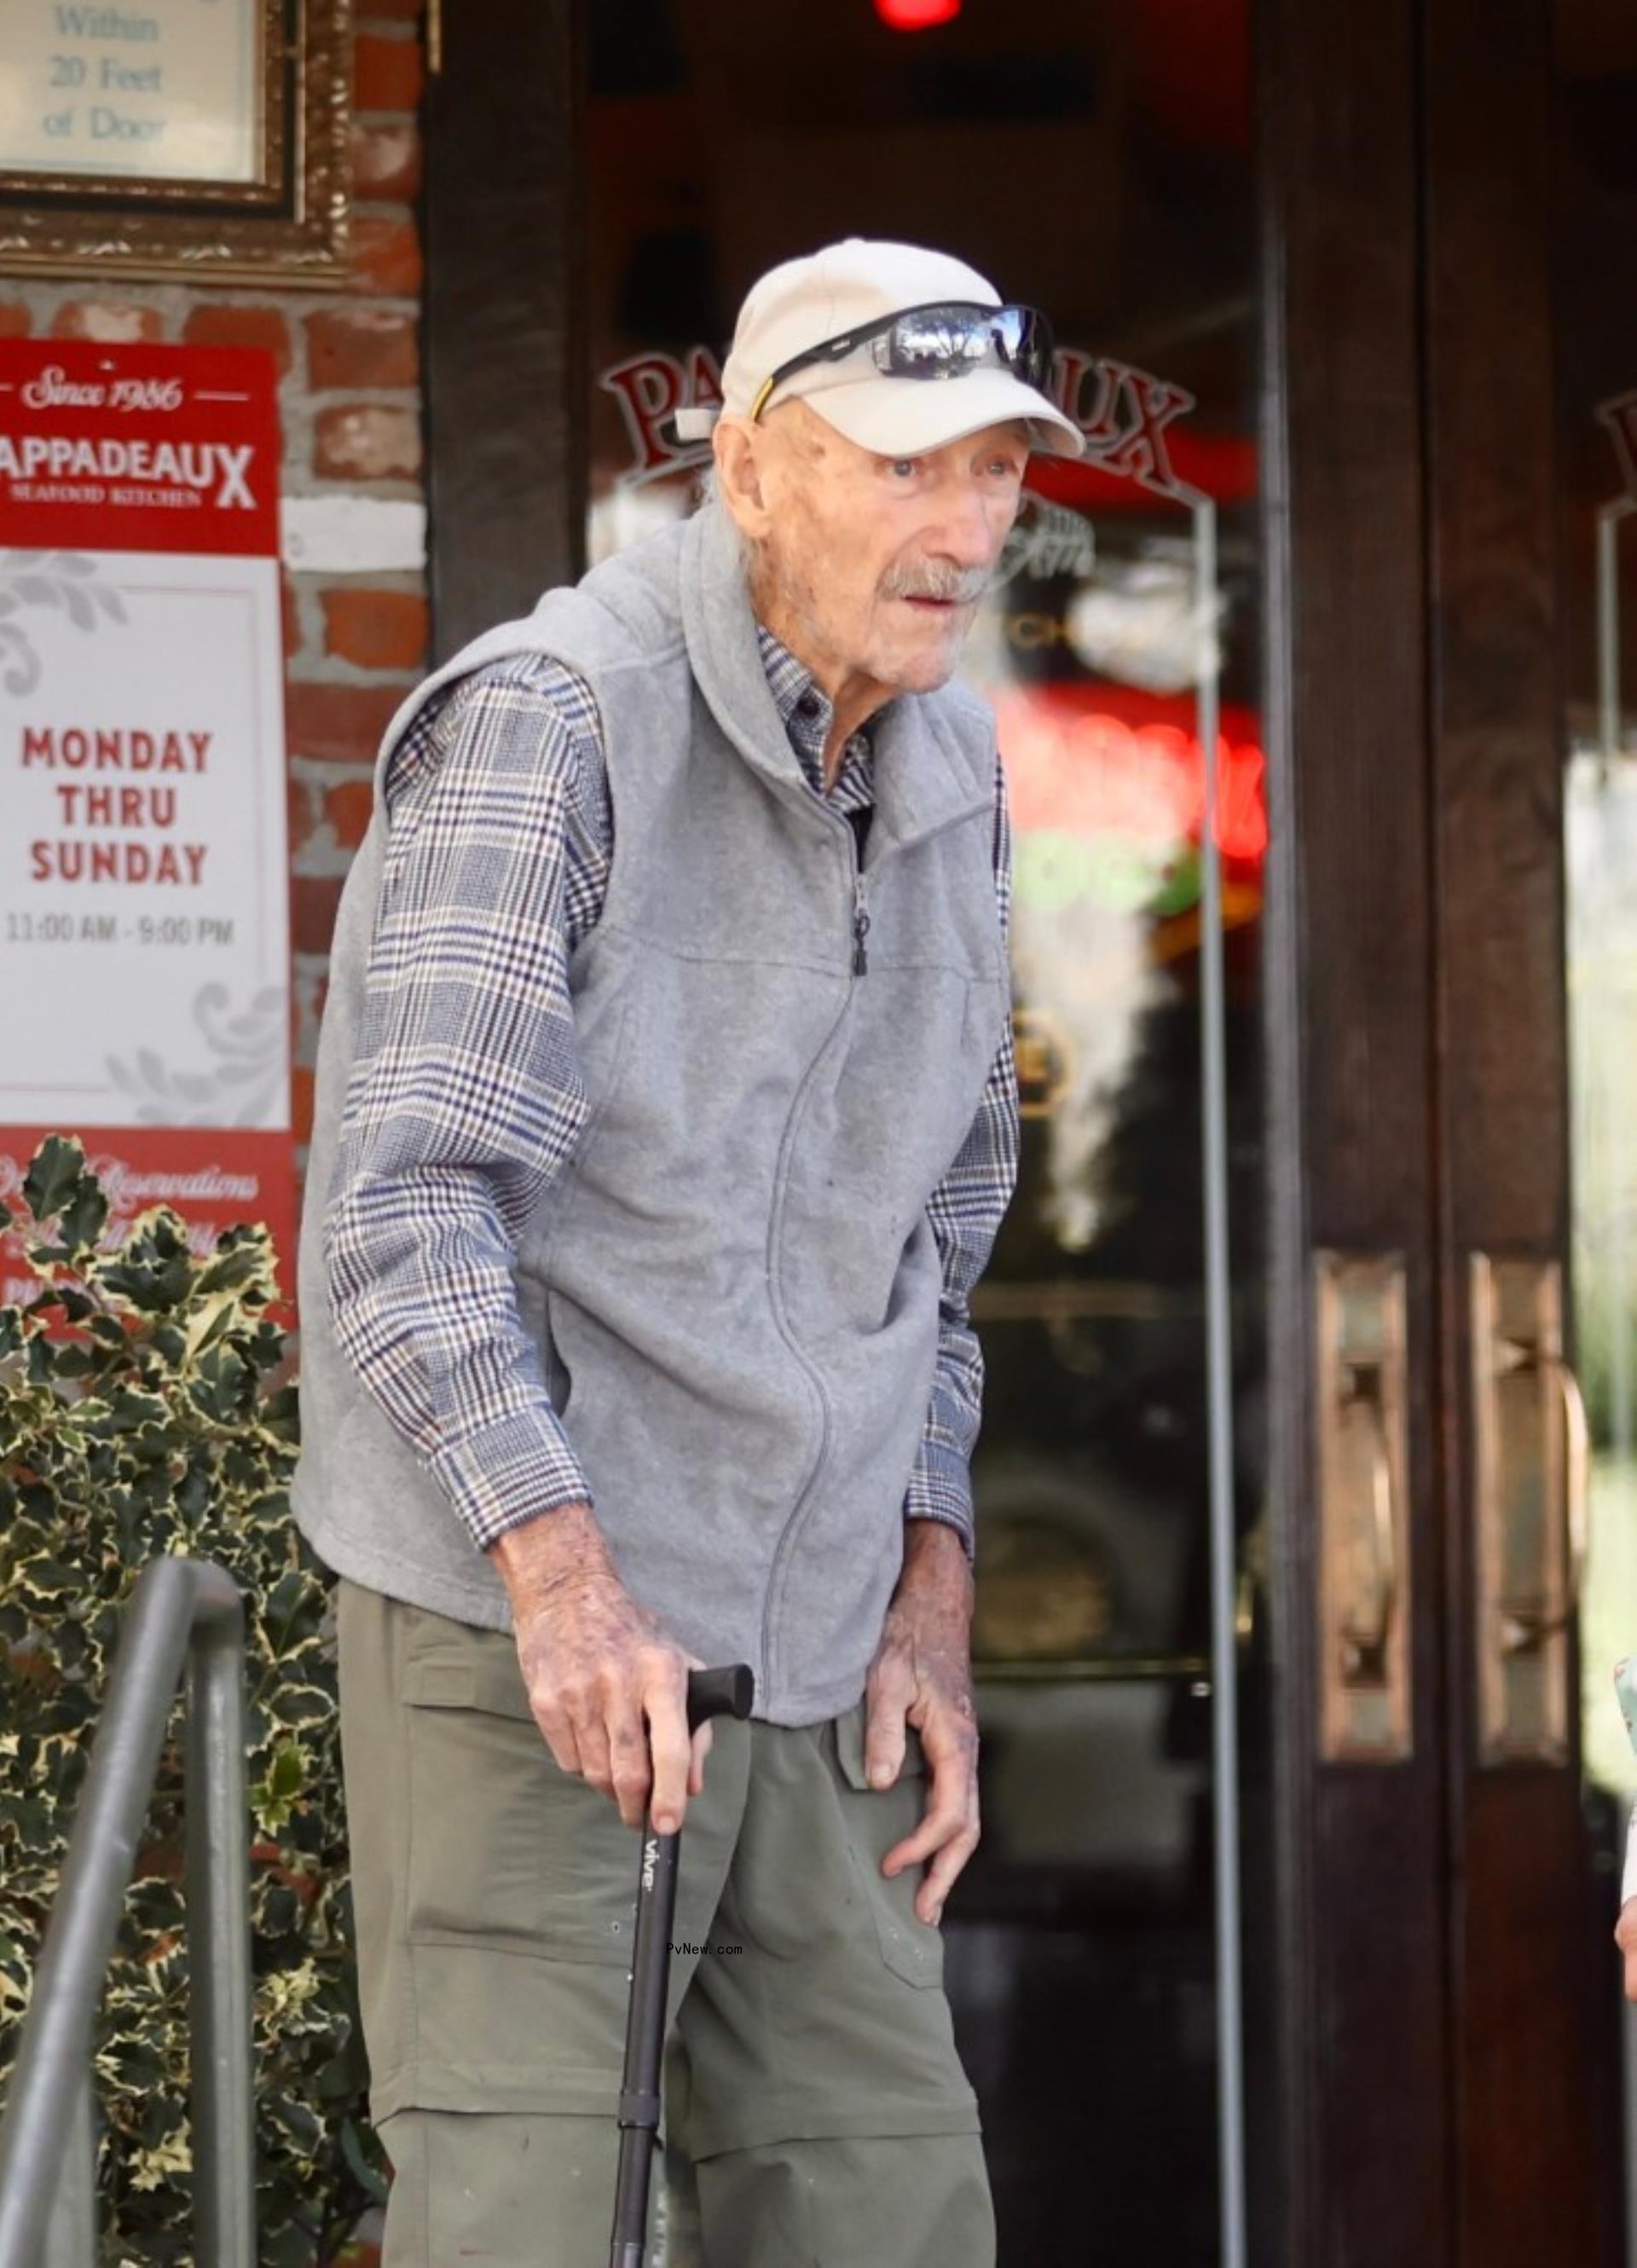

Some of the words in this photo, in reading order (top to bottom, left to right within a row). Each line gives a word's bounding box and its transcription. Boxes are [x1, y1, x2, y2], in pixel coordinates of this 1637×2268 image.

[55, 6, 159, 42] Within
[51, 57, 83, 87] 20
[101, 58, 161, 91] Feet
[43, 108, 74, 137] of
[90, 108, 165, 140] Door
[22, 365, 104, 409] Since
[0, 436, 257, 509] APPADEAUX
[22, 727, 211, 772] MONDAY
[56, 784, 176, 828] THRU
[31, 840, 207, 886] SUNDAY
[7, 911, 74, 943] 11:00
[80, 915, 117, 942] AM
[138, 916, 192, 945] 9:00
[197, 917, 234, 945] PM
[641, 1838, 660, 1891] vive
